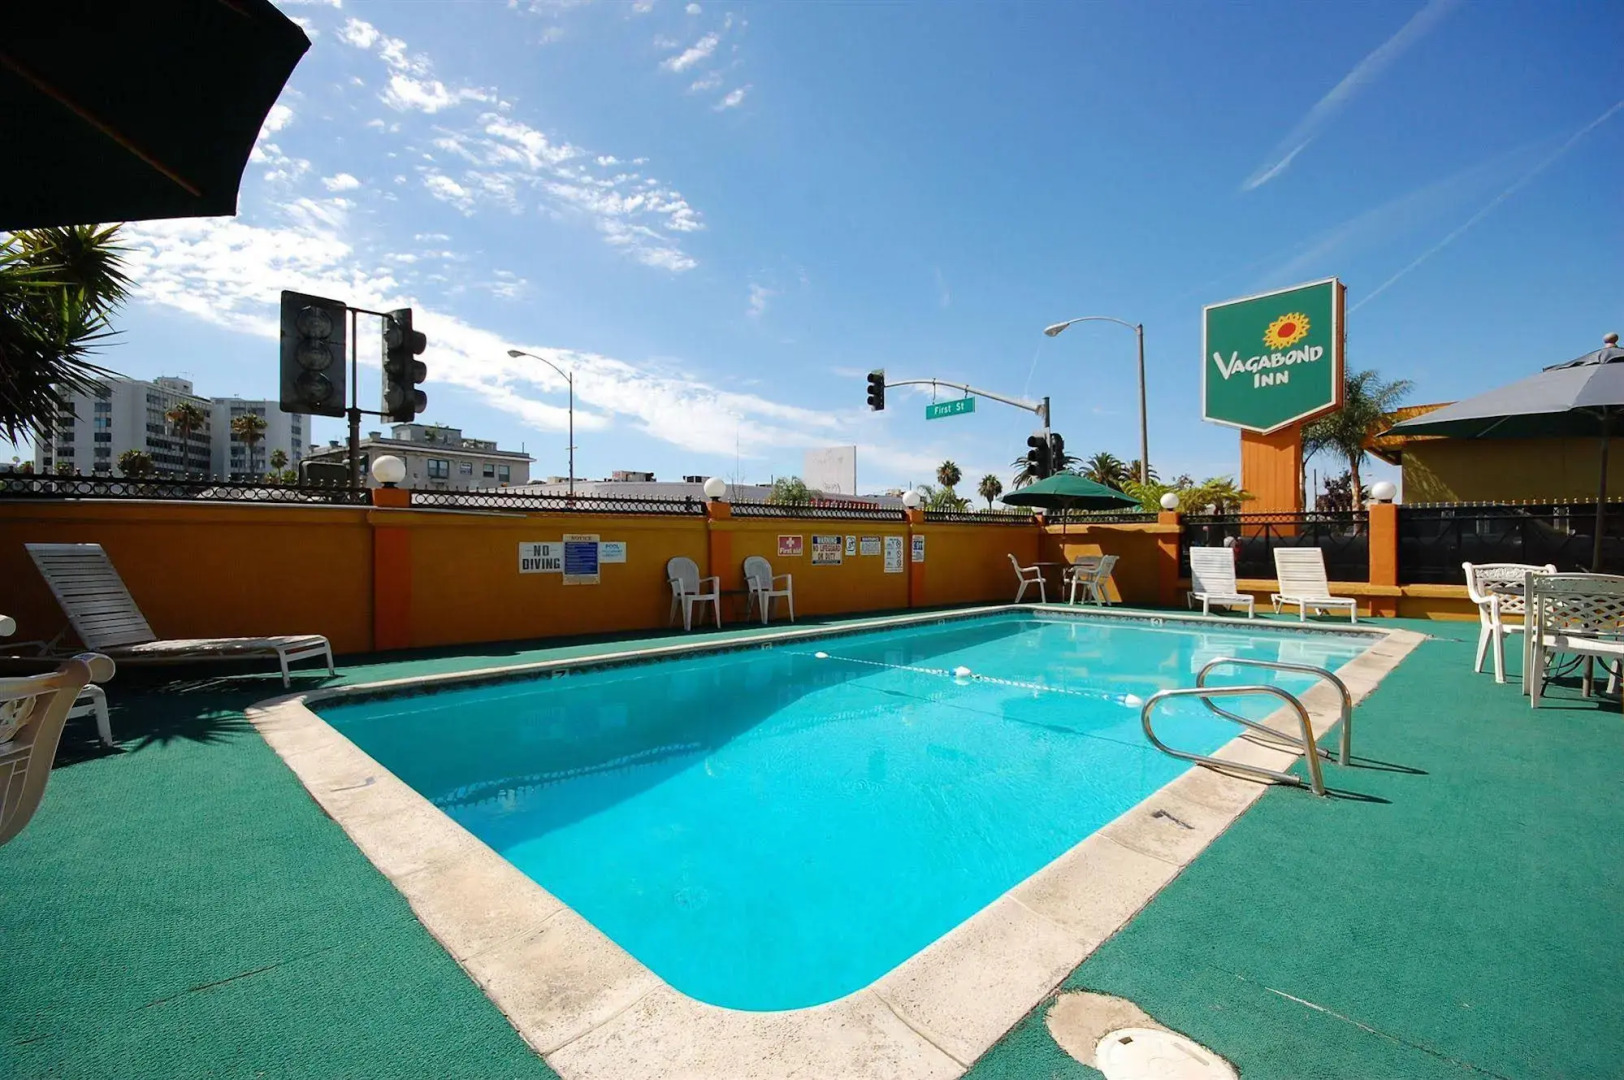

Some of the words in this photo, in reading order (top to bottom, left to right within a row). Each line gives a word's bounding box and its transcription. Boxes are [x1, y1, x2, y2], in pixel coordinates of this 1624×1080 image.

[1213, 345, 1324, 381] VAGABOND
[1253, 370, 1289, 389] INN
[934, 405, 951, 415] First
[956, 402, 964, 411] St
[533, 545, 550, 557] NO
[825, 552, 836, 560] DUTY
[522, 558, 561, 570] DIVING
